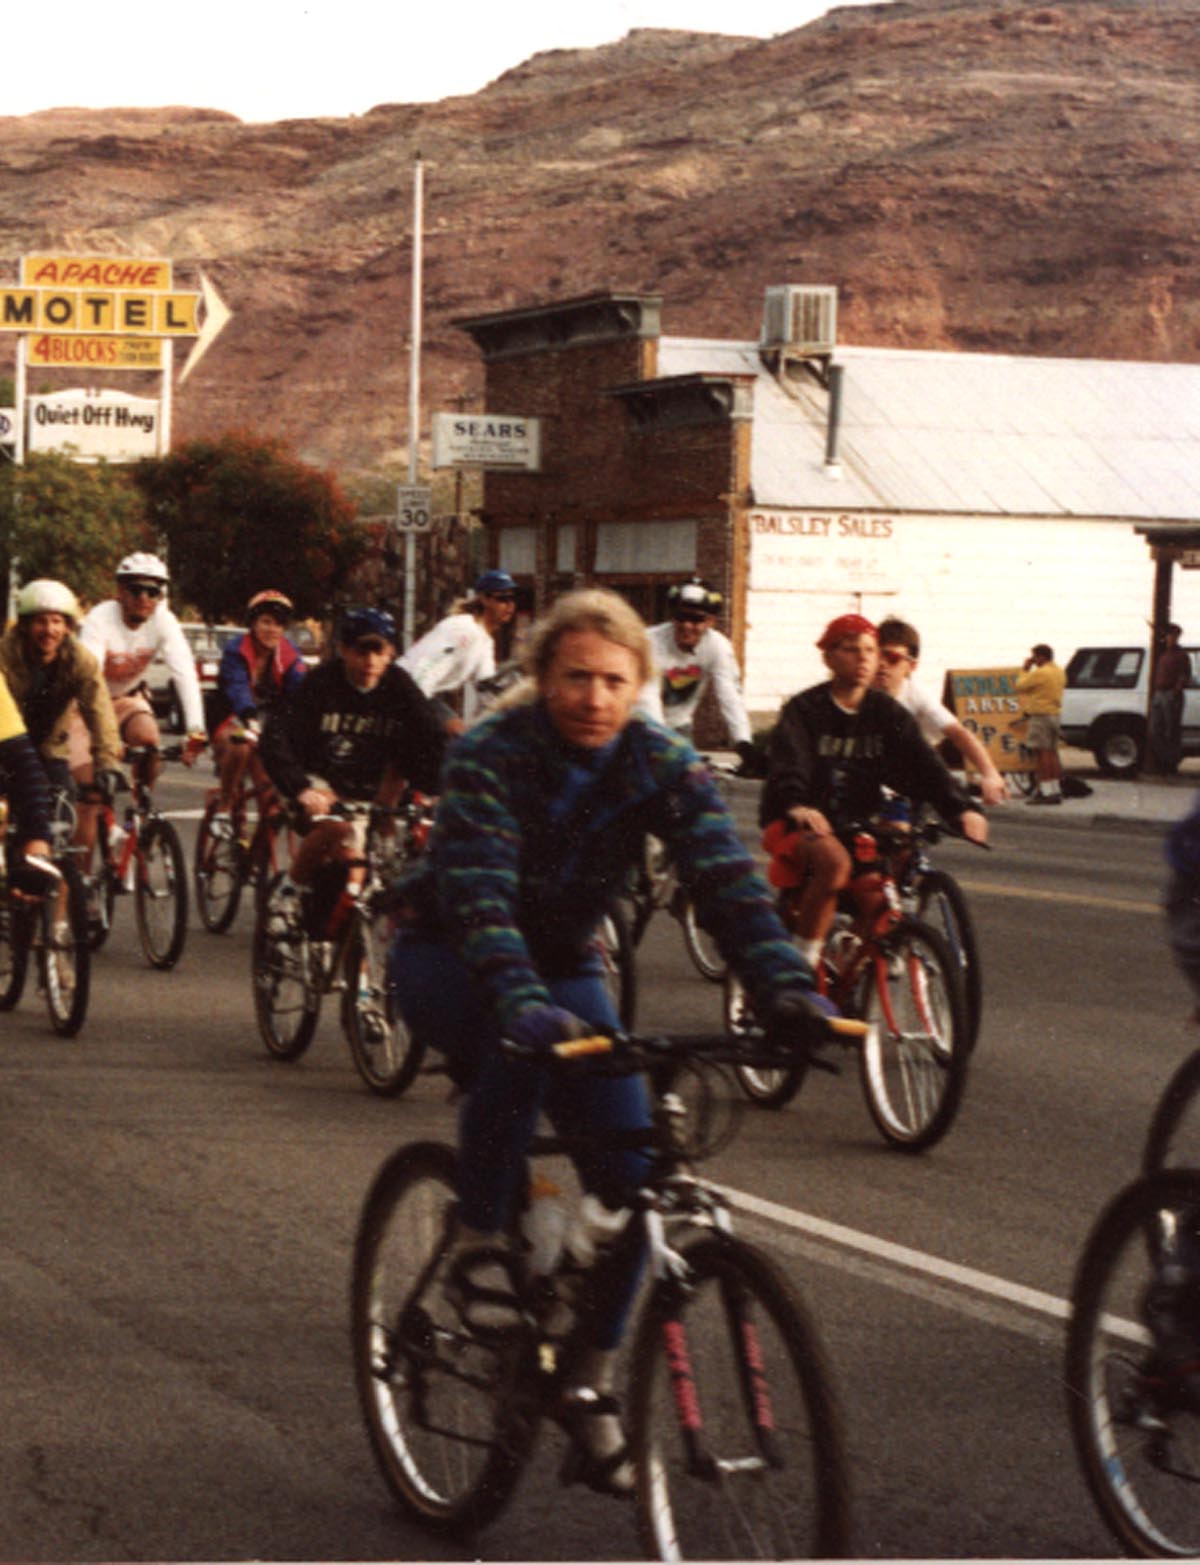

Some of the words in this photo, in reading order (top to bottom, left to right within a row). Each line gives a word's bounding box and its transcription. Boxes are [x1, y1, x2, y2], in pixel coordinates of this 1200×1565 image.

[34, 262, 162, 286] APACHE
[3, 294, 188, 328] MOTEL
[35, 402, 79, 426] Quiet
[82, 404, 112, 427] Off
[115, 406, 155, 433] Hwy
[454, 422, 527, 438] SEARS
[400, 509, 429, 527] 30
[752, 514, 832, 537] BALSLEY
[838, 514, 894, 538] SALES
[967, 697, 1020, 713] ARTS
